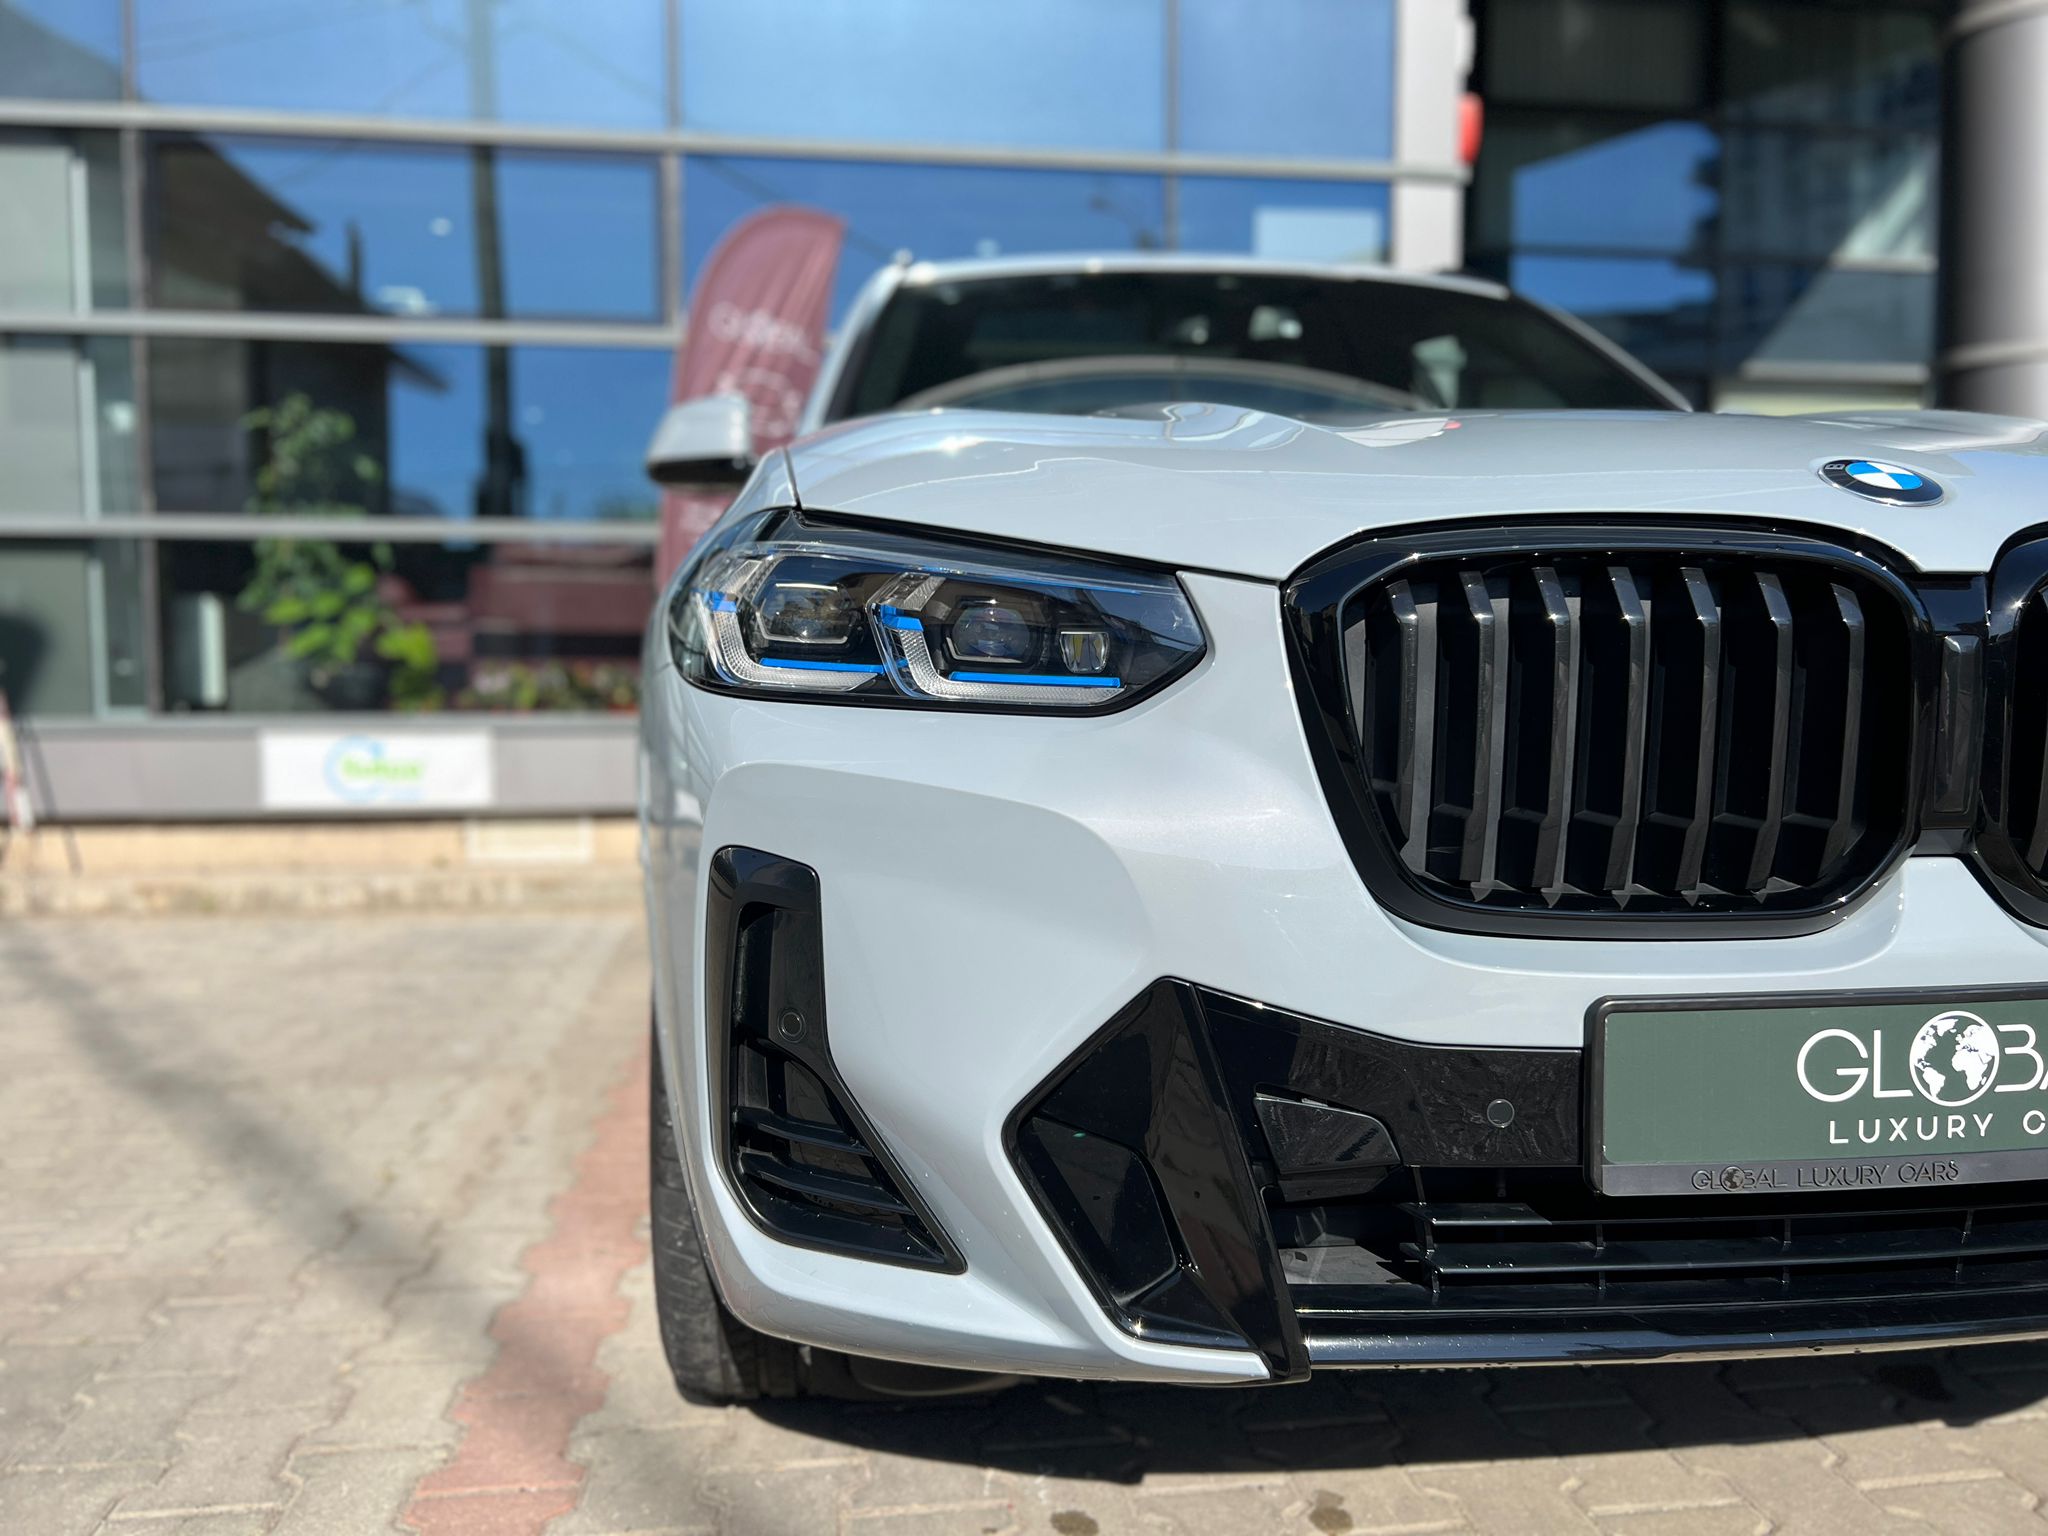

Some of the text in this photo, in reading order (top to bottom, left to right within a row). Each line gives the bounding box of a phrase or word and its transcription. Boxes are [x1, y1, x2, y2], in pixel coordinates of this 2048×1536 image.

[1797, 1010, 2048, 1106] GLOB
[1829, 1113, 1993, 1144] LUXURY
[1691, 1160, 1959, 1192] GLOBAL LUXURY CARS
